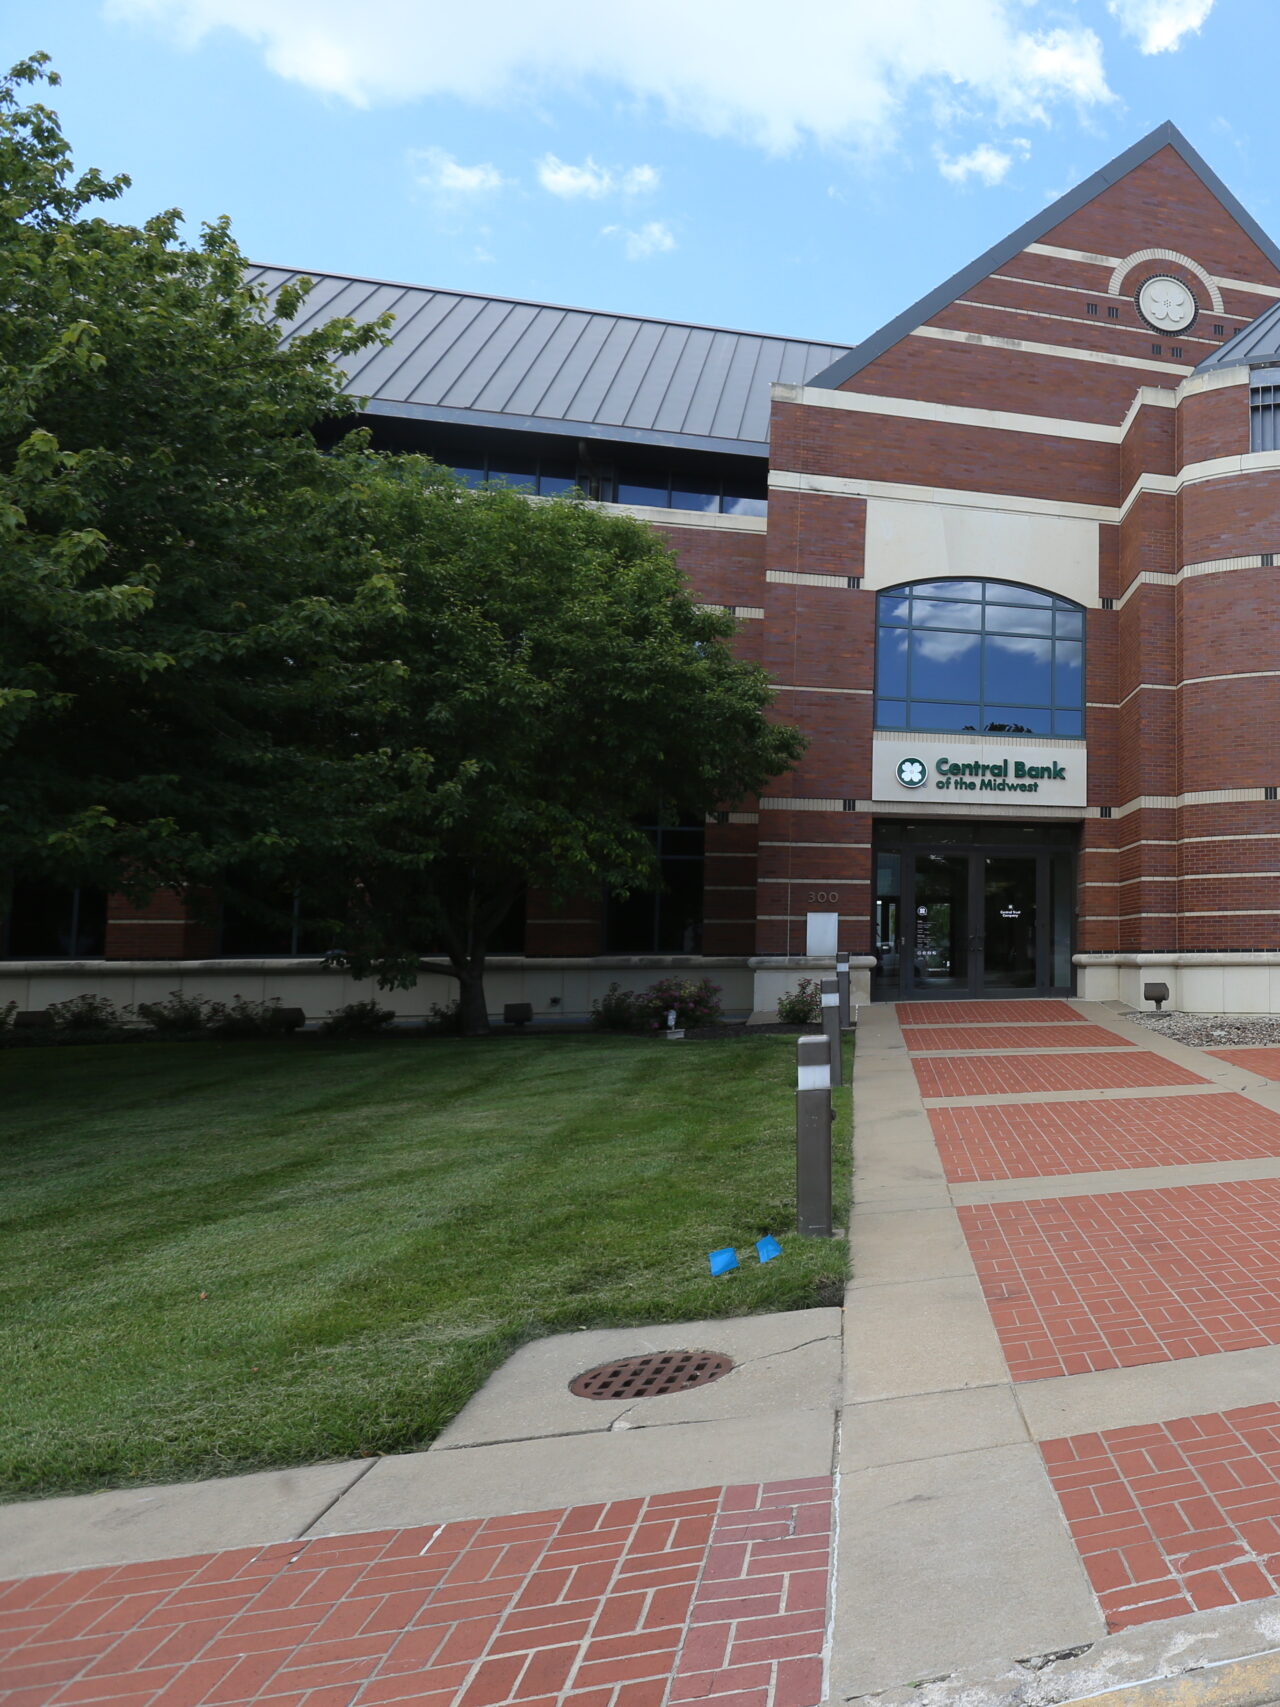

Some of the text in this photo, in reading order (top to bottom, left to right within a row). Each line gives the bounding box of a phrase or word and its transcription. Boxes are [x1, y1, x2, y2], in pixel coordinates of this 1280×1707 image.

[935, 757, 1066, 780] Central Bank
[936, 777, 1039, 793] of the Midwest
[808, 891, 839, 903] 300
